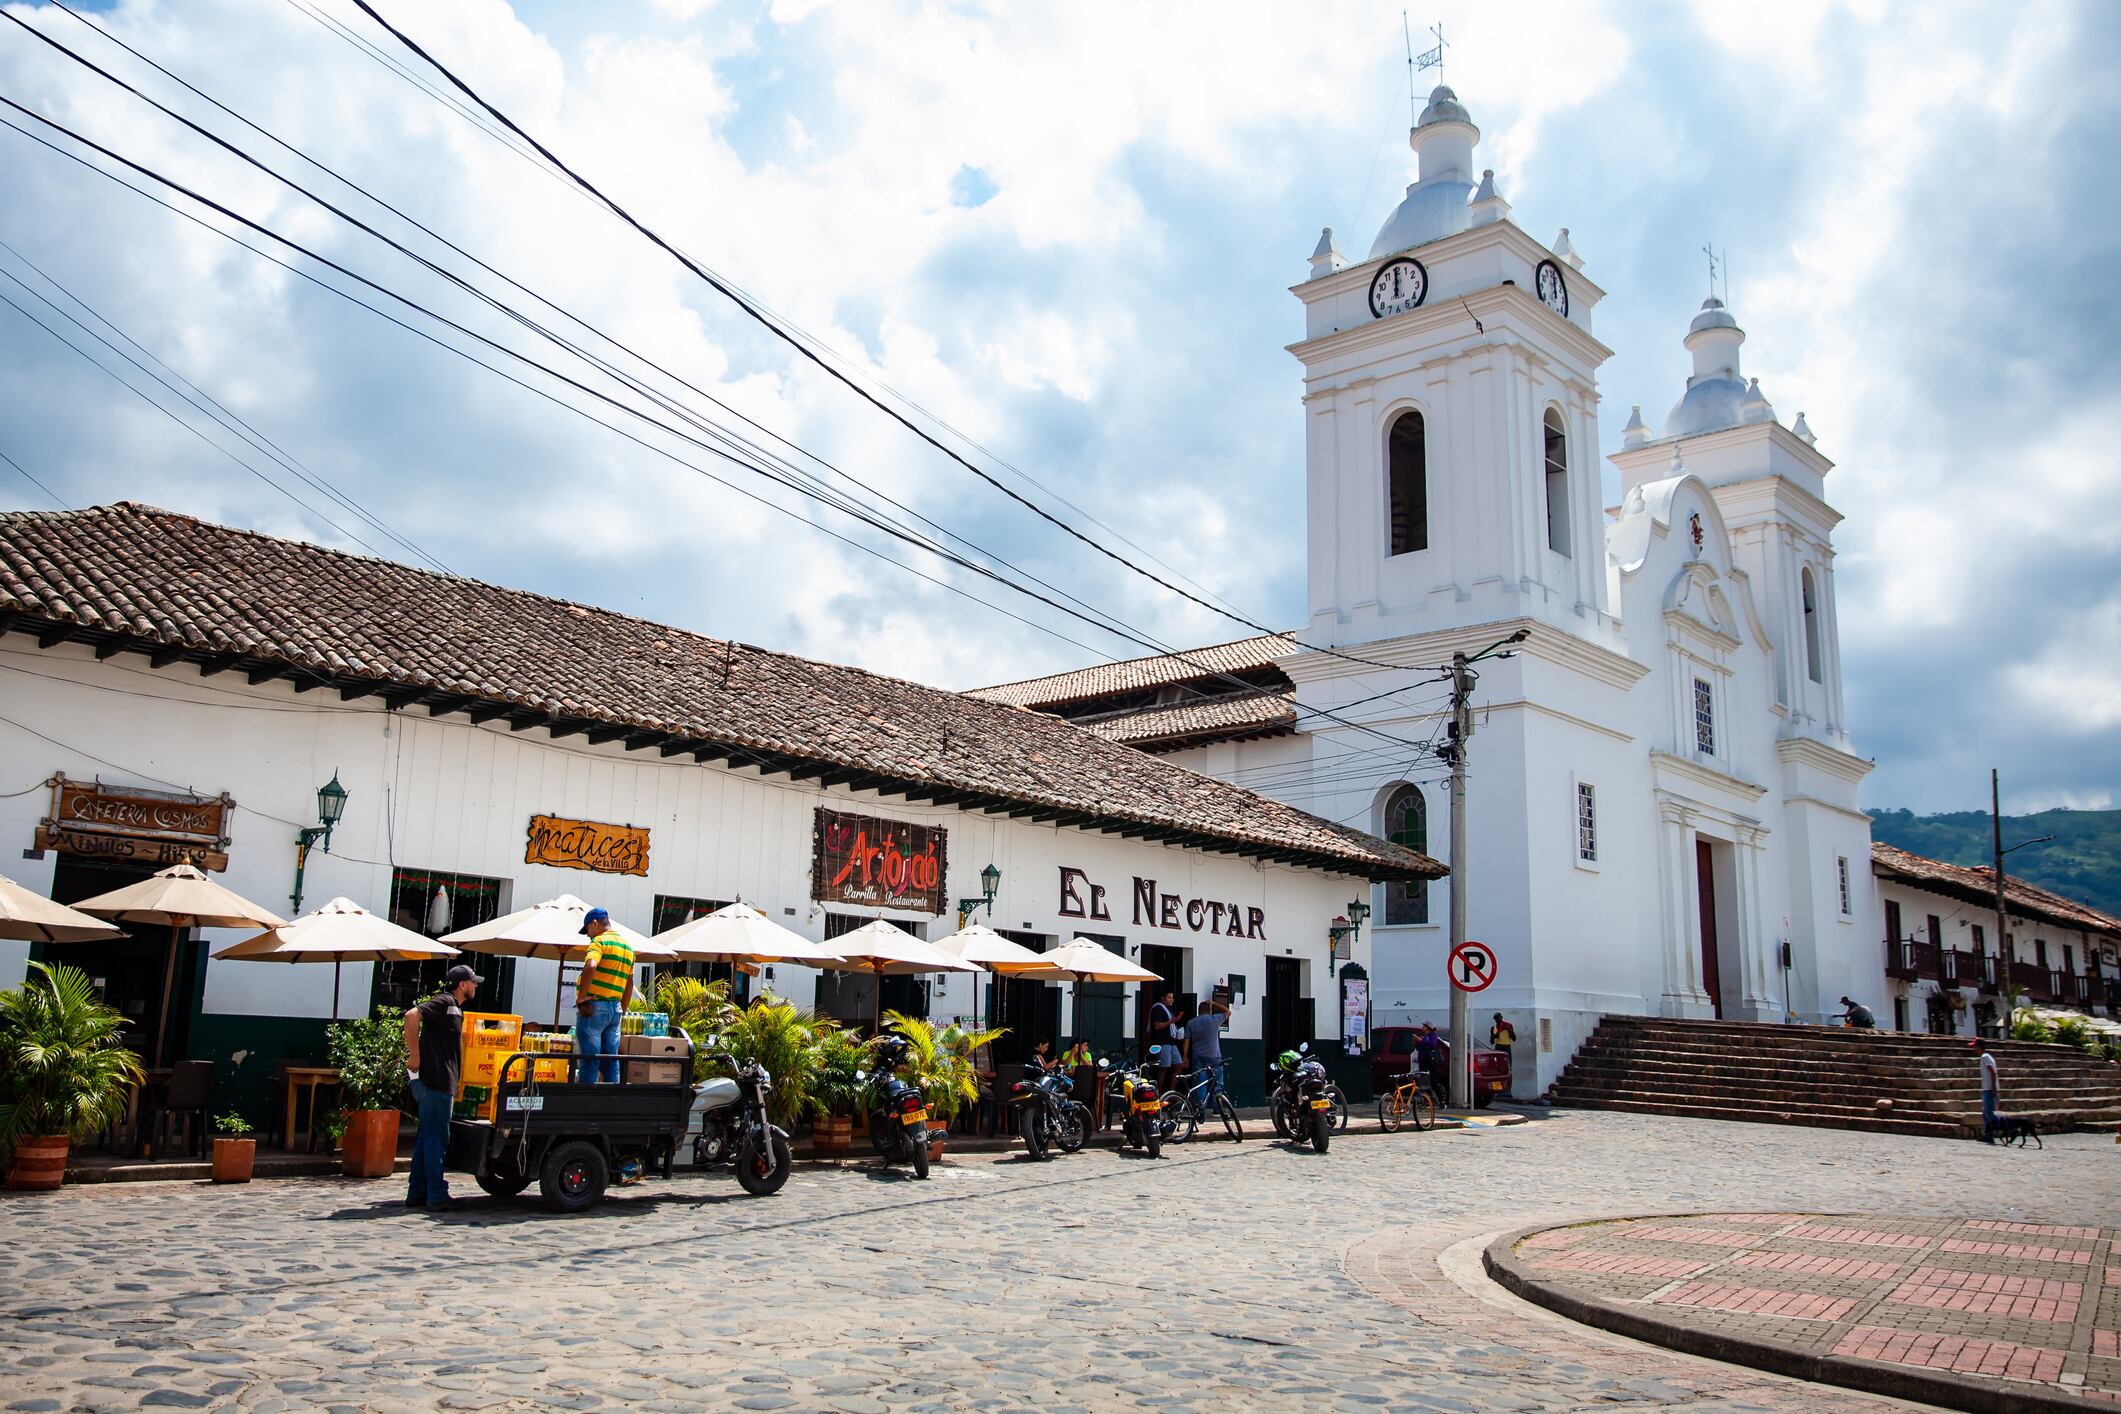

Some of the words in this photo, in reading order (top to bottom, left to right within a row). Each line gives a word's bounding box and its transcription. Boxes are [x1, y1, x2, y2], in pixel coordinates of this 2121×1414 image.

[1404, 267, 1407, 275] 1
[1410, 271, 1415, 279] 2
[1385, 273, 1391, 282] 11
[1379, 282, 1386, 292] 10
[1415, 281, 1420, 289] 3
[1376, 293, 1381, 301] 9
[1411, 292, 1416, 300] 4
[1380, 302, 1385, 310] 8
[1405, 299, 1410, 308] 5
[1388, 305, 1392, 315] 7
[1396, 305, 1401, 313] 6
[825, 824, 850, 850] El
[843, 884, 877, 900] Parrilla
[884, 891, 928, 907] Restaurante
[1464, 952, 1485, 982] P
